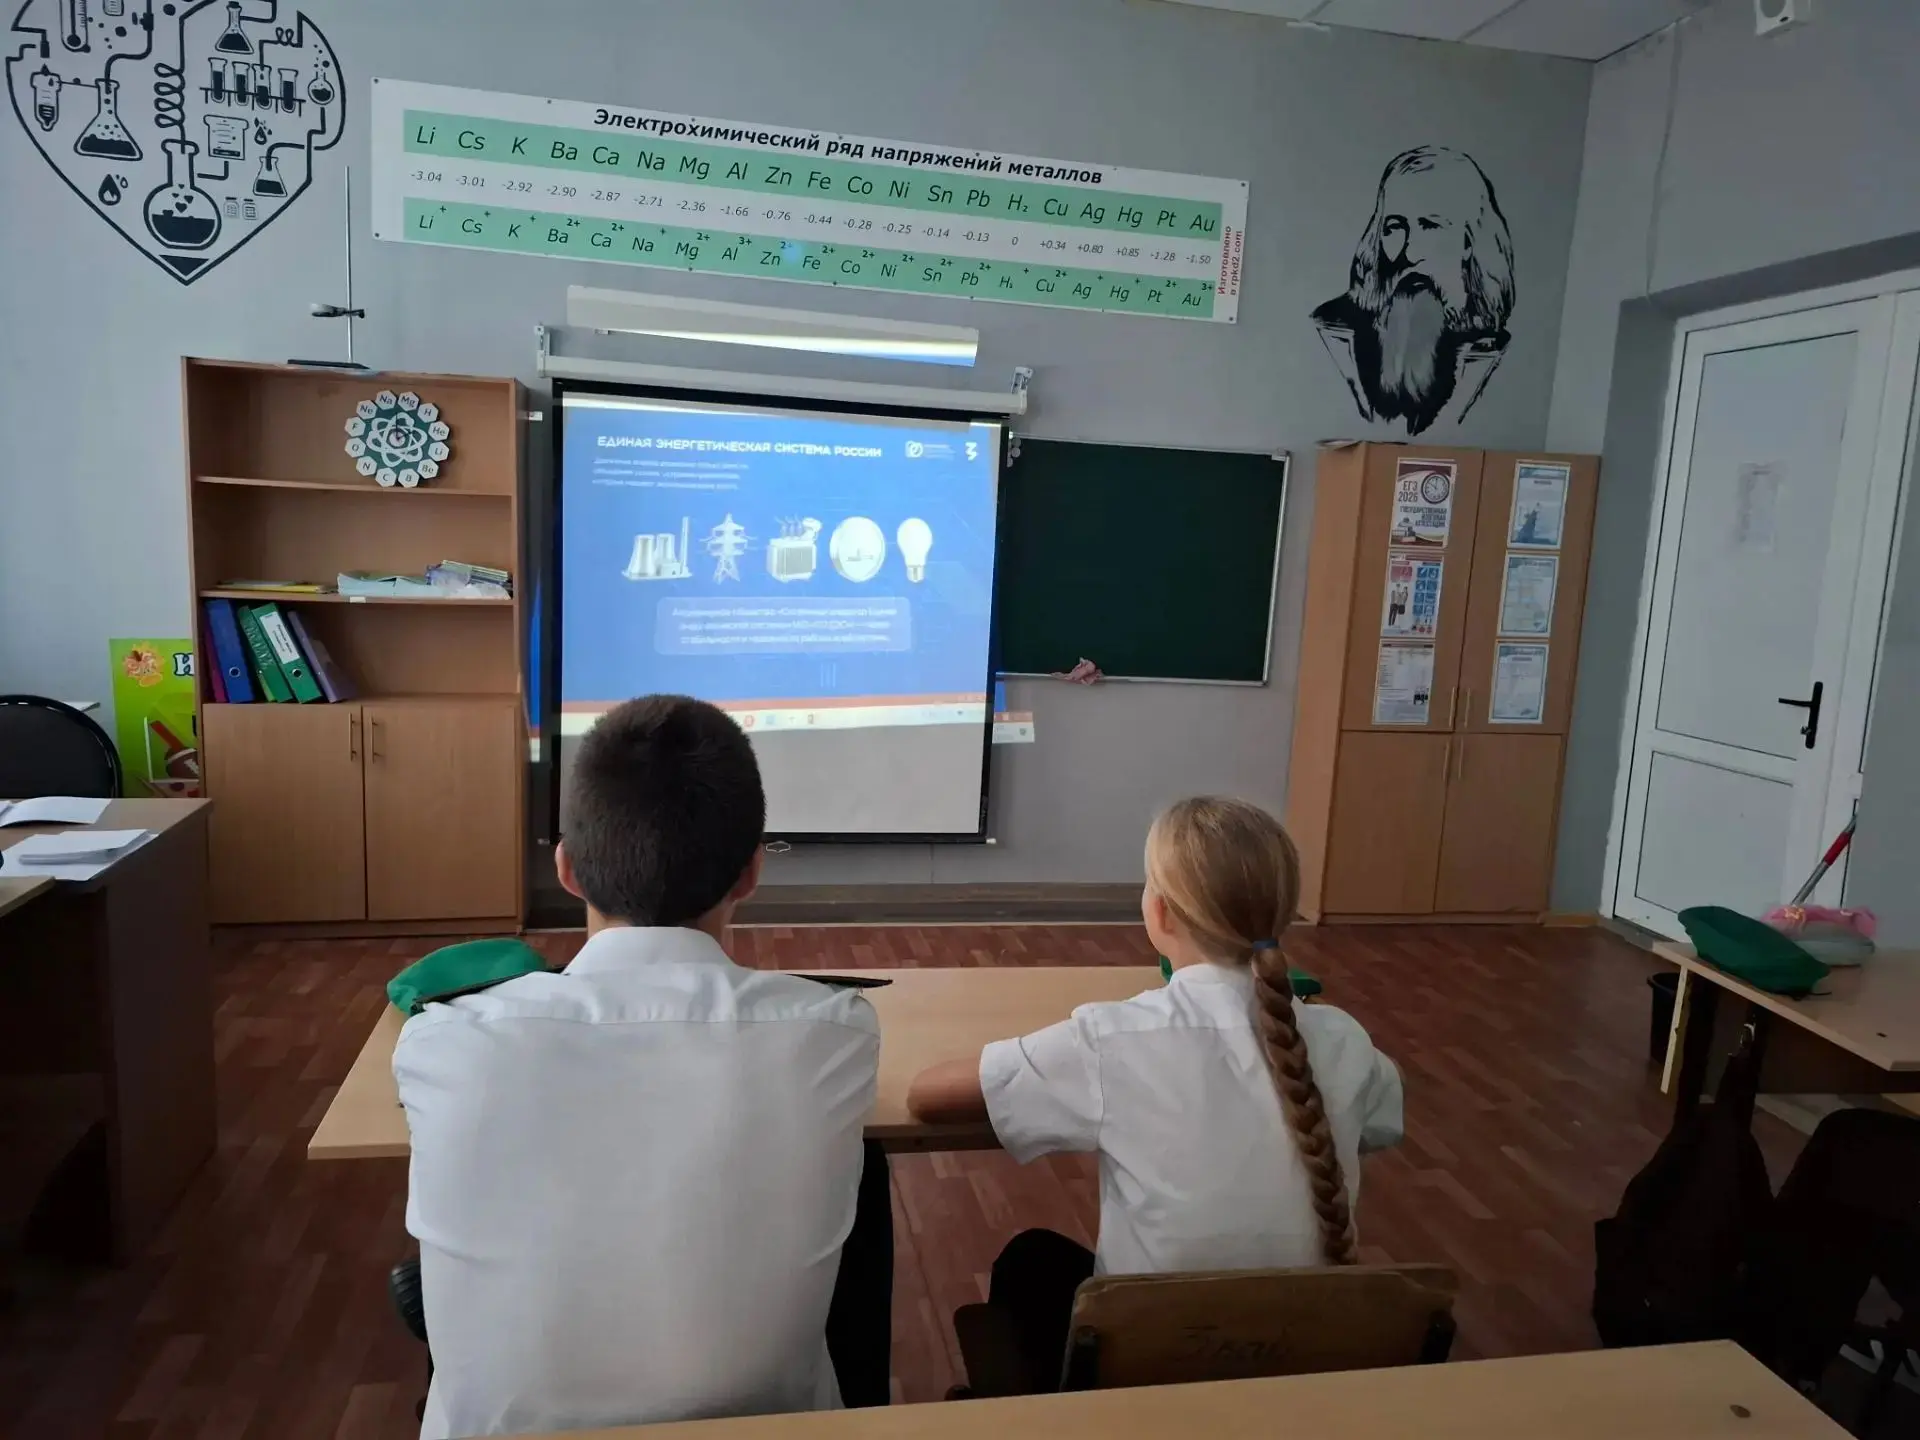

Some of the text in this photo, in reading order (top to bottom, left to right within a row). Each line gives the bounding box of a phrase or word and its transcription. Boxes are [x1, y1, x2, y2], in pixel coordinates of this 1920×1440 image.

[416, 125, 436, 145] Li
[458, 130, 486, 151] Cs
[511, 136, 528, 156] K
[550, 141, 578, 161] Ba
[592, 146, 620, 166] Ca
[637, 150, 666, 171] Na
[679, 155, 711, 180] Mg
[726, 162, 748, 180] Al
[764, 166, 793, 186] Zn
[807, 171, 832, 190] Fe
[847, 176, 873, 195] Co
[889, 180, 911, 199] Ni
[927, 185, 953, 204] Sn
[966, 189, 990, 208] Pb
[1043, 198, 1069, 216] Cu
[1080, 202, 1105, 224] Ag
[1117, 205, 1143, 228] Hg
[1156, 210, 1177, 228] Pt
[1189, 214, 1216, 232] Au
[593, 108, 1102, 184] Электрохимический ряд напряжений металлов
[411, 170, 1211, 264] -3.04 -3.01 -2.92 -2.90 -2.87 -2.71 -2.36 -1.66 -0.76 -0.44 -0.28 -0.25 -0.14 -0.13 0 +0.34 +0.80 +0.85 -1.28 -1.50
[1217, 226, 1231, 295] Изготовлено
[1231, 231, 1243, 286] rpkd2.com
[597, 436, 882, 457] ЕДИНАЯ ЭНЕРГЕТИЧЕСКАЯ СИСТЕМА РОССИИ
[1398, 492, 1418, 502] 2026
